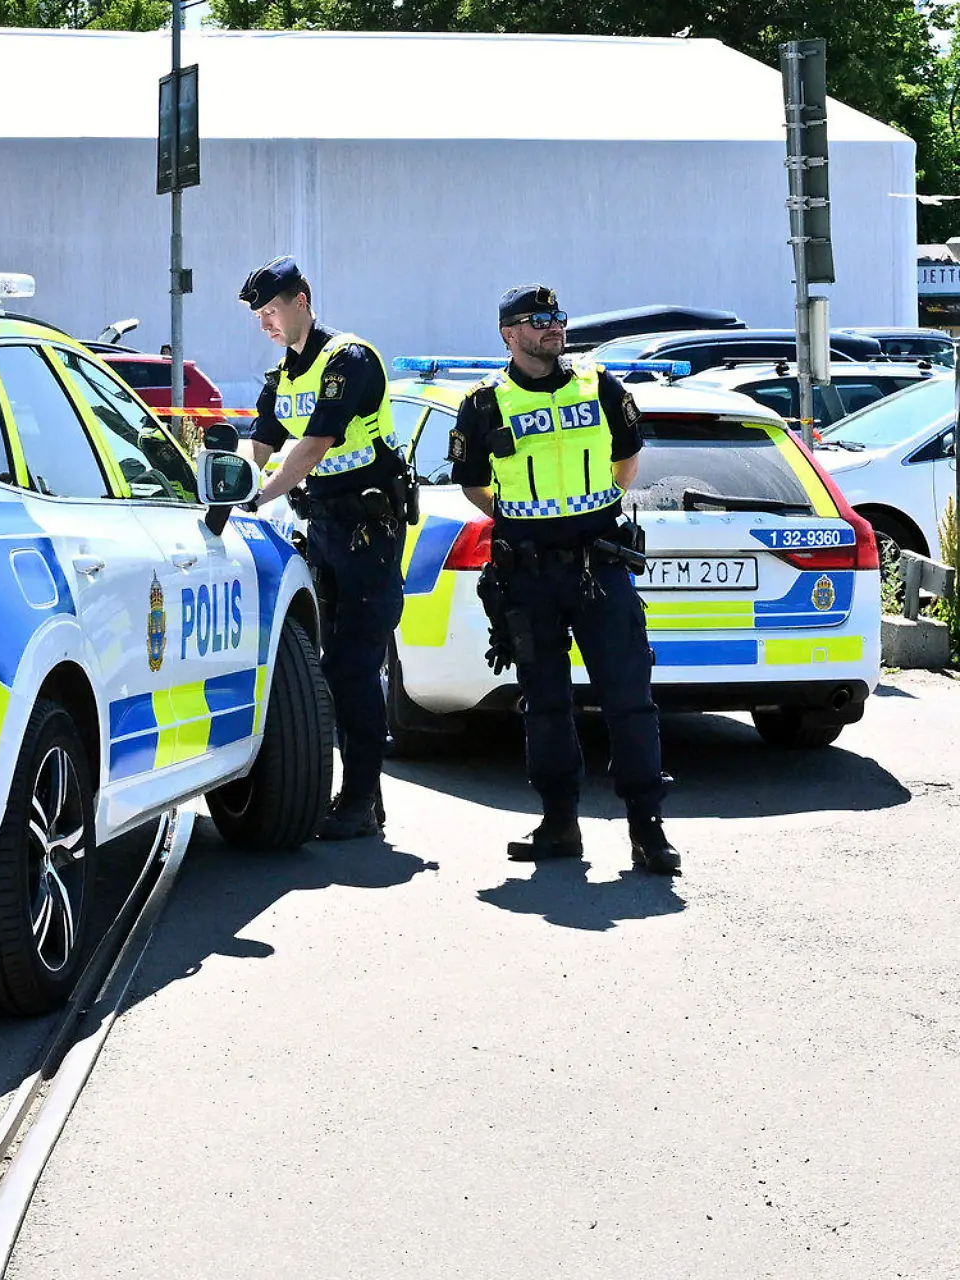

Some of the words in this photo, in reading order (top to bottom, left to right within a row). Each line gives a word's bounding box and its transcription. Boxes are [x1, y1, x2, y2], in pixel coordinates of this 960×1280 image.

[918, 268, 960, 284] JETT
[518, 402, 593, 434] POLIS
[770, 532, 778, 546] 1
[783, 530, 841, 546] 32-9360
[645, 561, 691, 584] YFM
[700, 561, 745, 584] 207
[180, 579, 242, 660] POLIS
